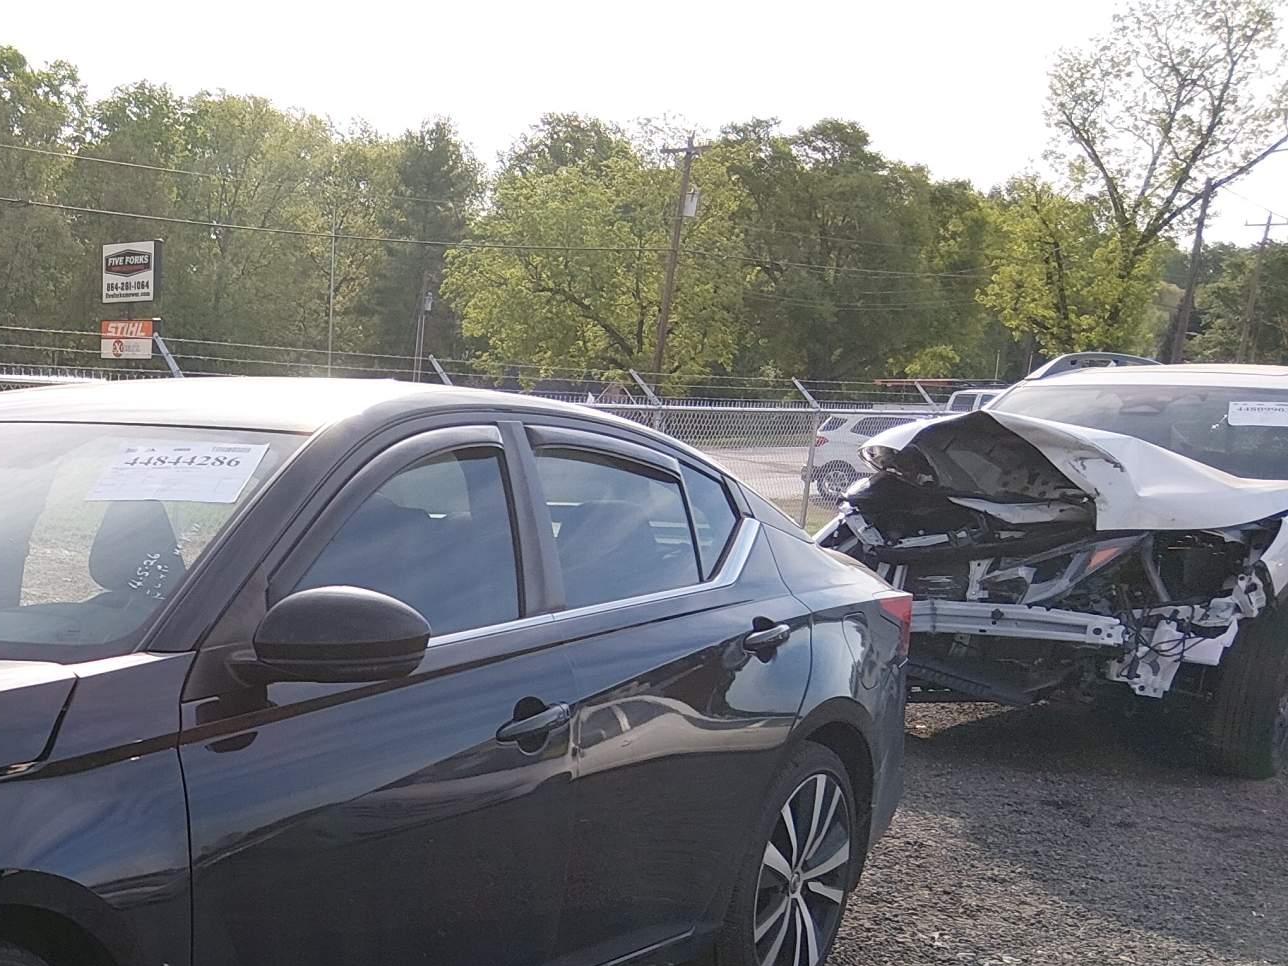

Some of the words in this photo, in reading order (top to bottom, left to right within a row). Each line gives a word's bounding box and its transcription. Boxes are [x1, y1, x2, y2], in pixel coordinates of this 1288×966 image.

[107, 257, 124, 266] FIVE
[124, 255, 149, 265] FORKS
[107, 322, 145, 337] STIHL
[124, 455, 241, 467] 44844286
